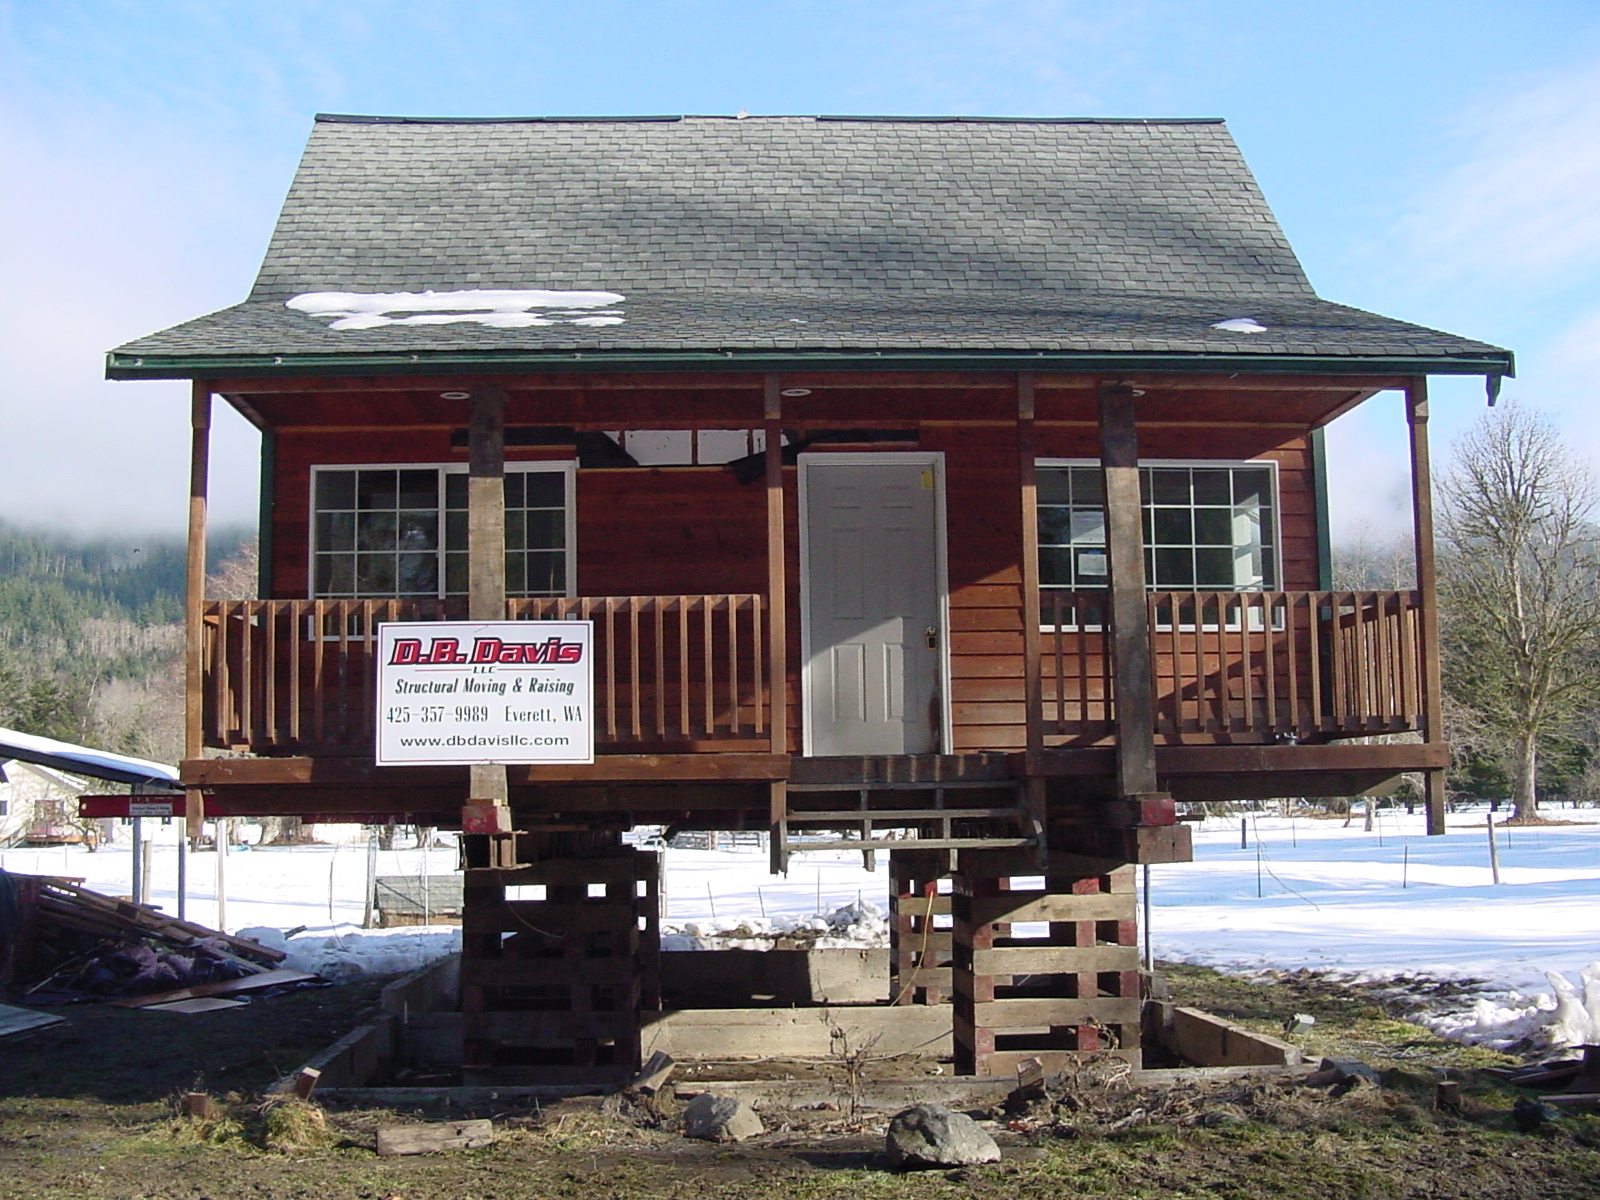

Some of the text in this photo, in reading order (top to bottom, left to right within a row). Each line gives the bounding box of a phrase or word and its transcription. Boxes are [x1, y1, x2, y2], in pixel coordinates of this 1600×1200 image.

[388, 637, 583, 666] D.B. Davis
[395, 678, 574, 695] Structural Moving & Raising
[505, 705, 557, 724] Everett,
[564, 705, 582, 722] WA
[401, 735, 569, 746] www.dbdavisllc.com
